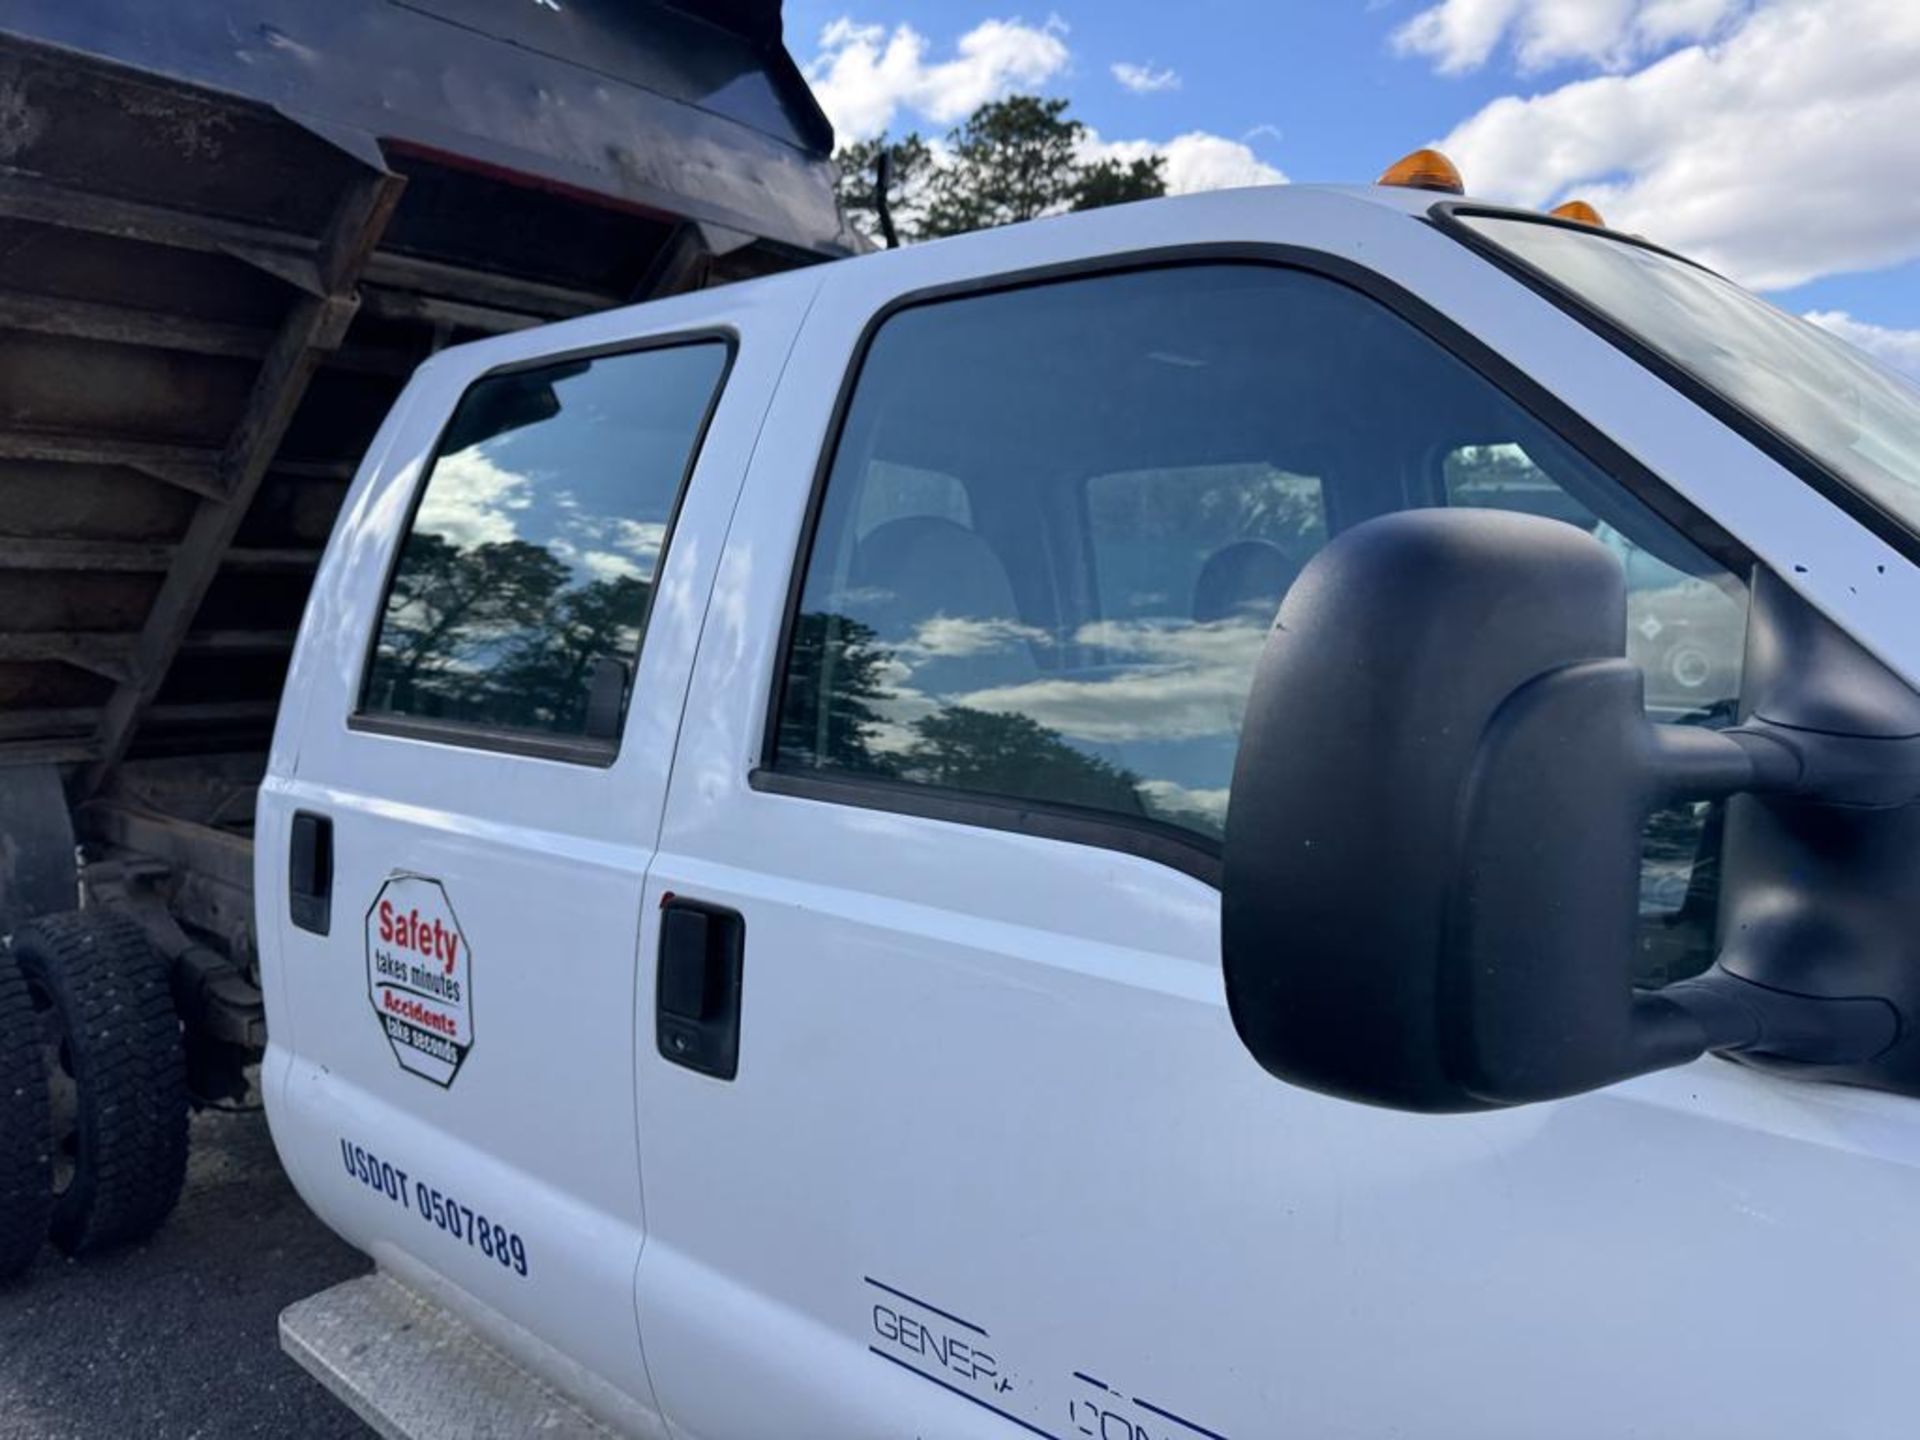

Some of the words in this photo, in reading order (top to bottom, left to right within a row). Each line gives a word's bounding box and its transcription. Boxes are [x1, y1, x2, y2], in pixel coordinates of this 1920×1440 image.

[378, 899, 458, 975] Safety
[375, 948, 408, 982] takes
[411, 963, 461, 1002] minutes
[384, 989, 457, 1036] Accidents
[341, 1138, 409, 1208] USDOT
[416, 1181, 528, 1276] 0507889
